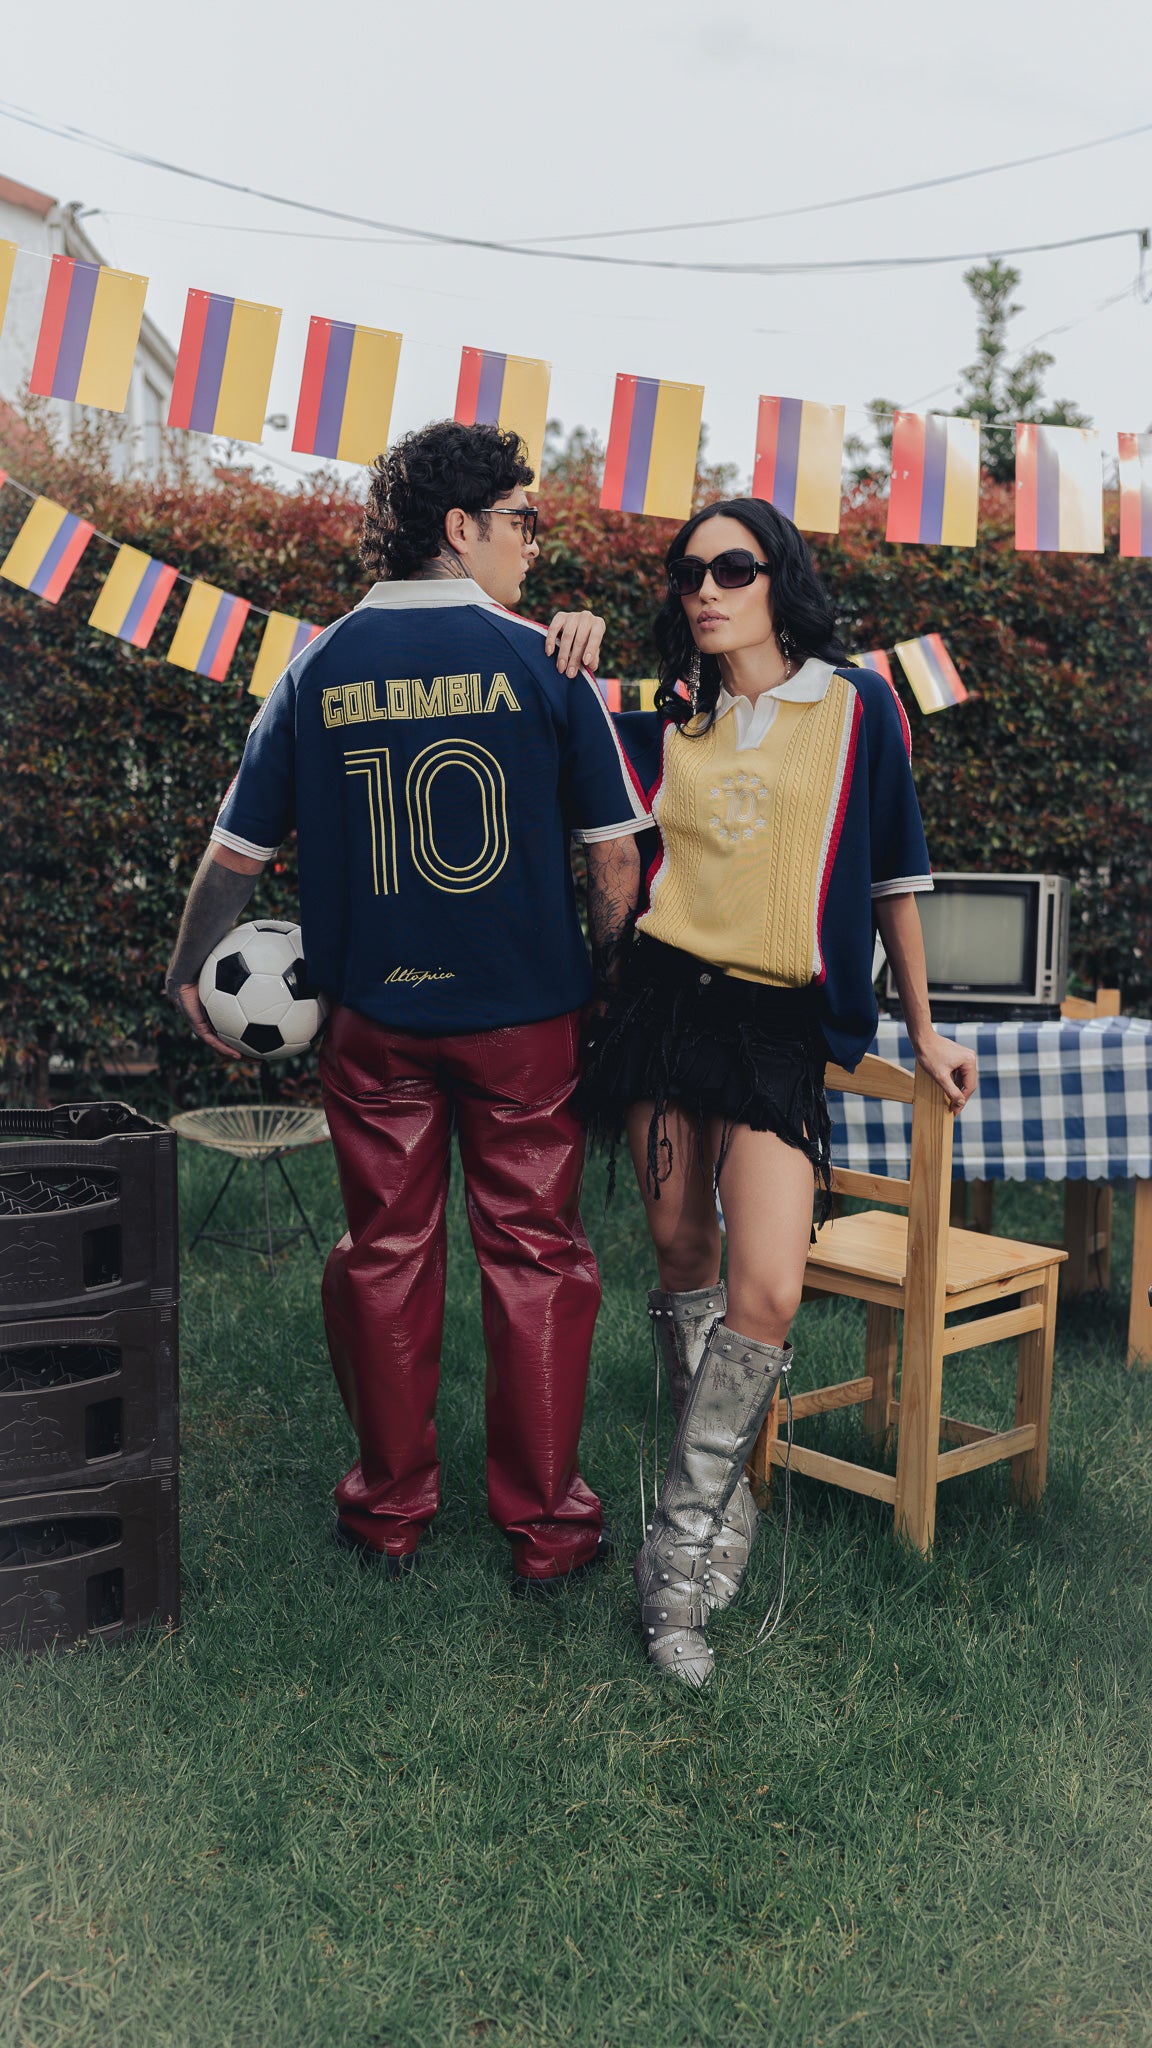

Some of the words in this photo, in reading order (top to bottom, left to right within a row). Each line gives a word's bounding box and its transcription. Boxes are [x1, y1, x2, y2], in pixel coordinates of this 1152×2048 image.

[321, 672, 522, 729] COLOMBIA
[343, 738, 510, 896] 10
[725, 789, 755, 823] 10
